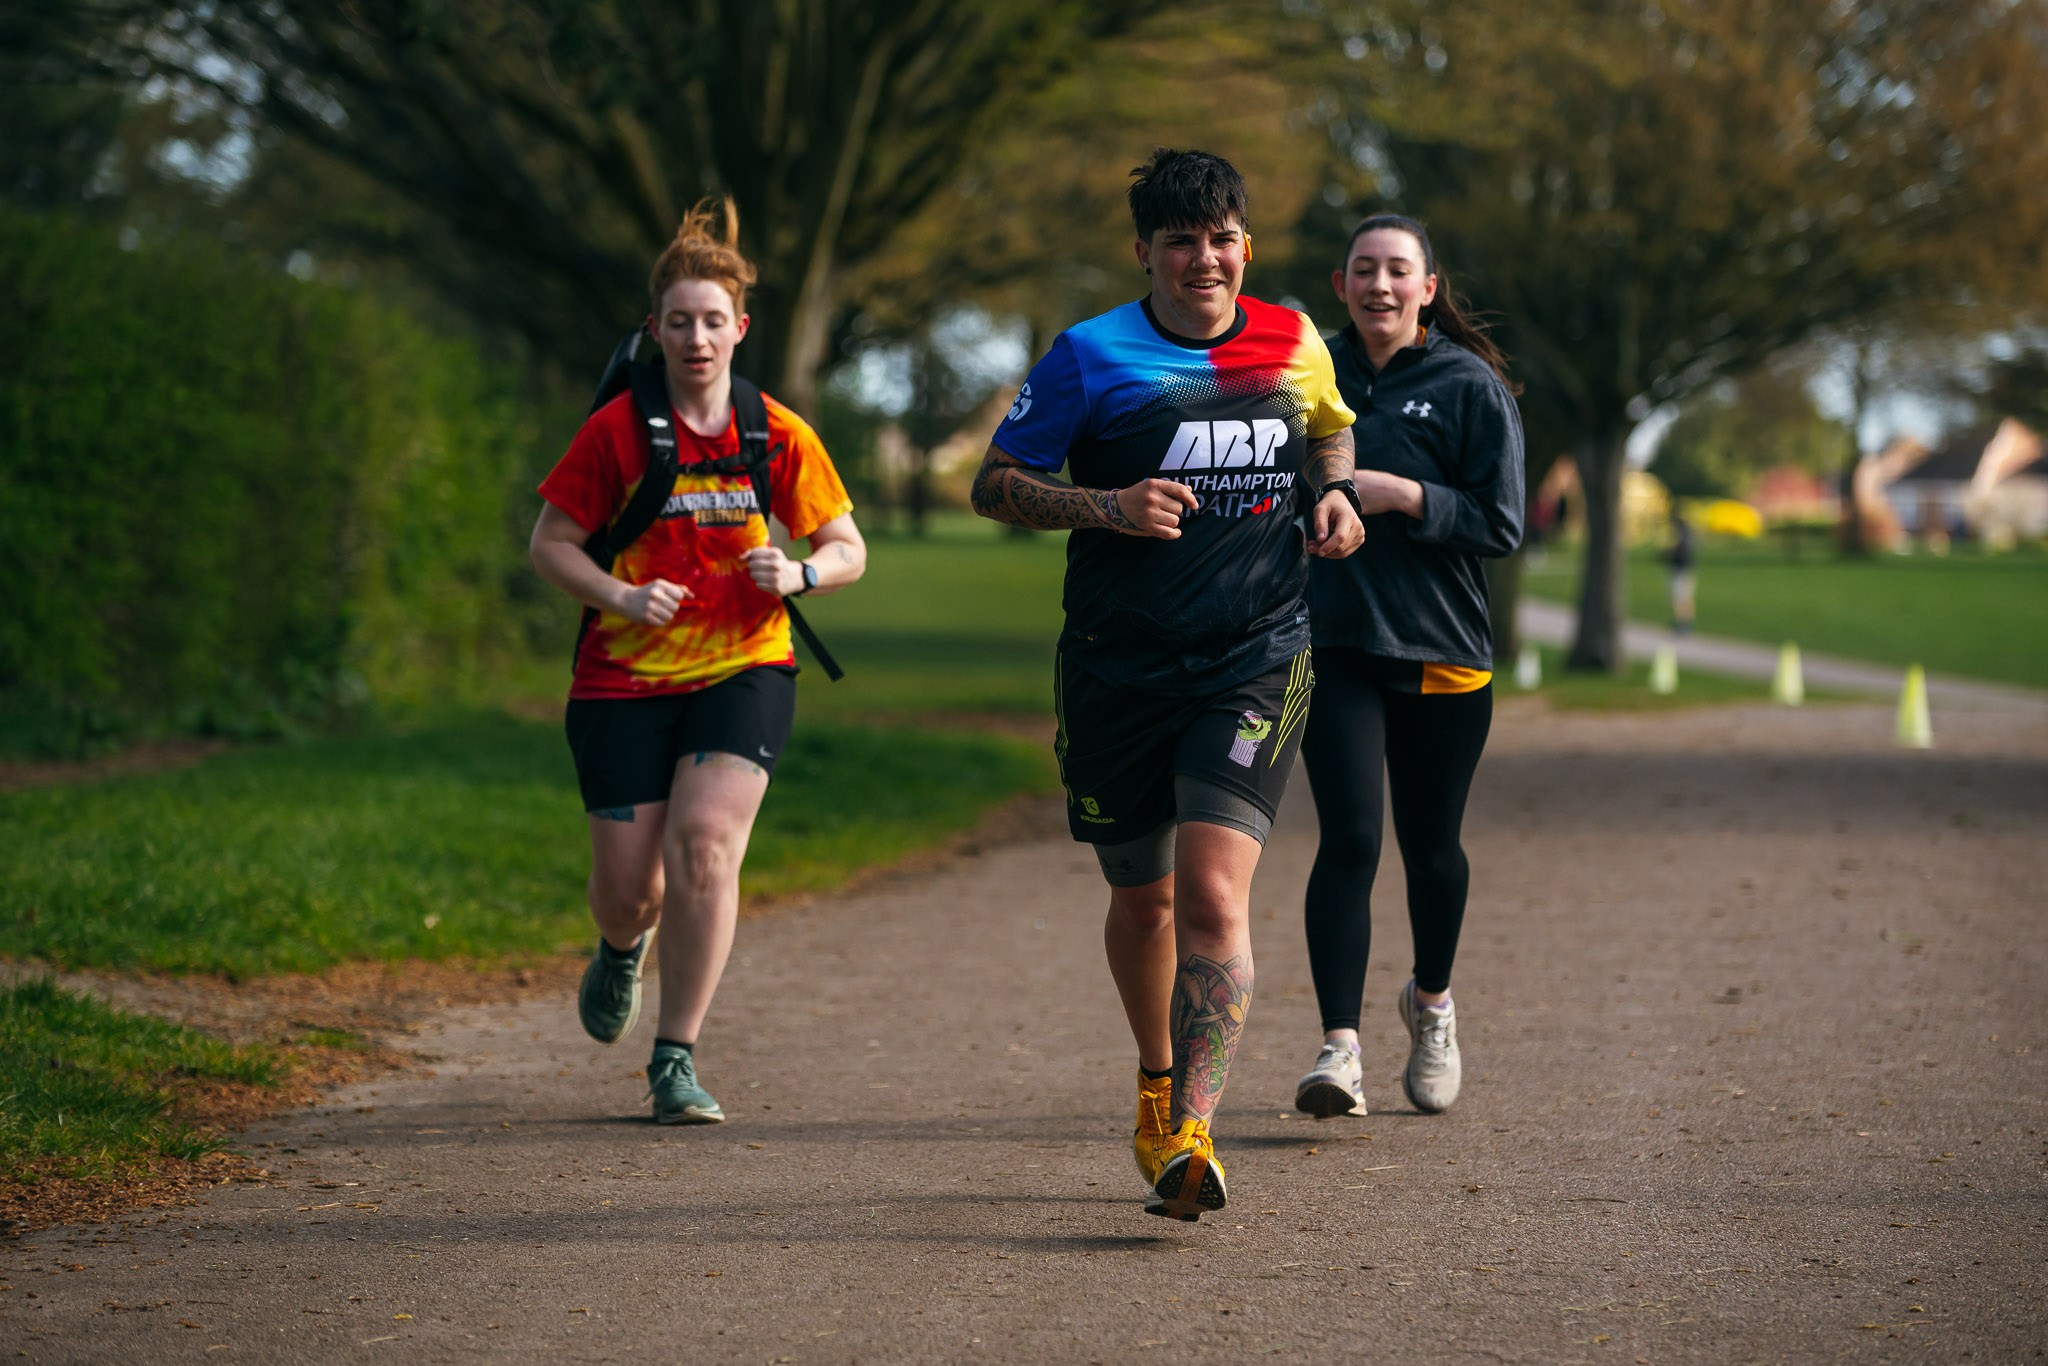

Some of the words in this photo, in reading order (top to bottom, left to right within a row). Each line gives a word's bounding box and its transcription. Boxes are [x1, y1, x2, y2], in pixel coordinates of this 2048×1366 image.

[1159, 418, 1289, 471] ABP
[1144, 472, 1296, 492] THAMPTON
[661, 491, 759, 515] OURNEMOUT
